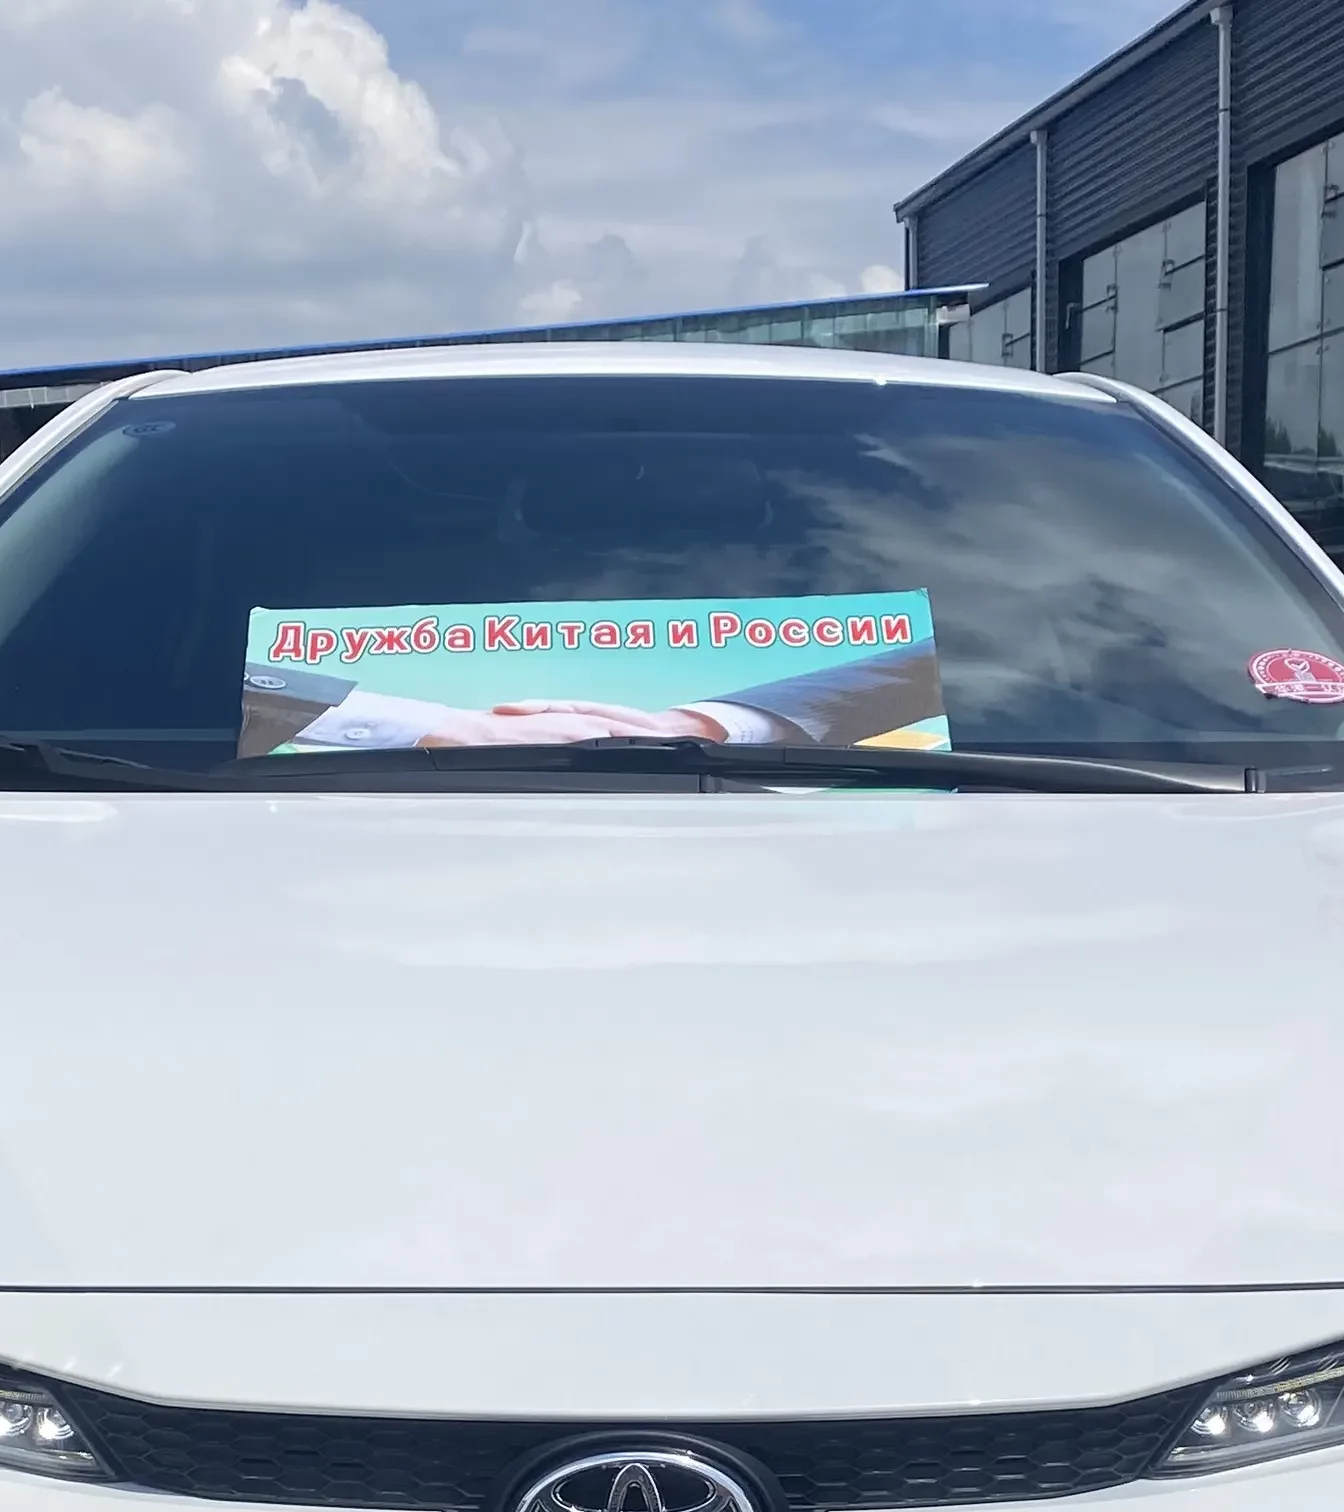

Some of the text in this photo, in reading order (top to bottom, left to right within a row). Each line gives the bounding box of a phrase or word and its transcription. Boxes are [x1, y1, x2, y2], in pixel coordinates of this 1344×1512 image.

[268, 611, 913, 664] Дружба Китая и России
